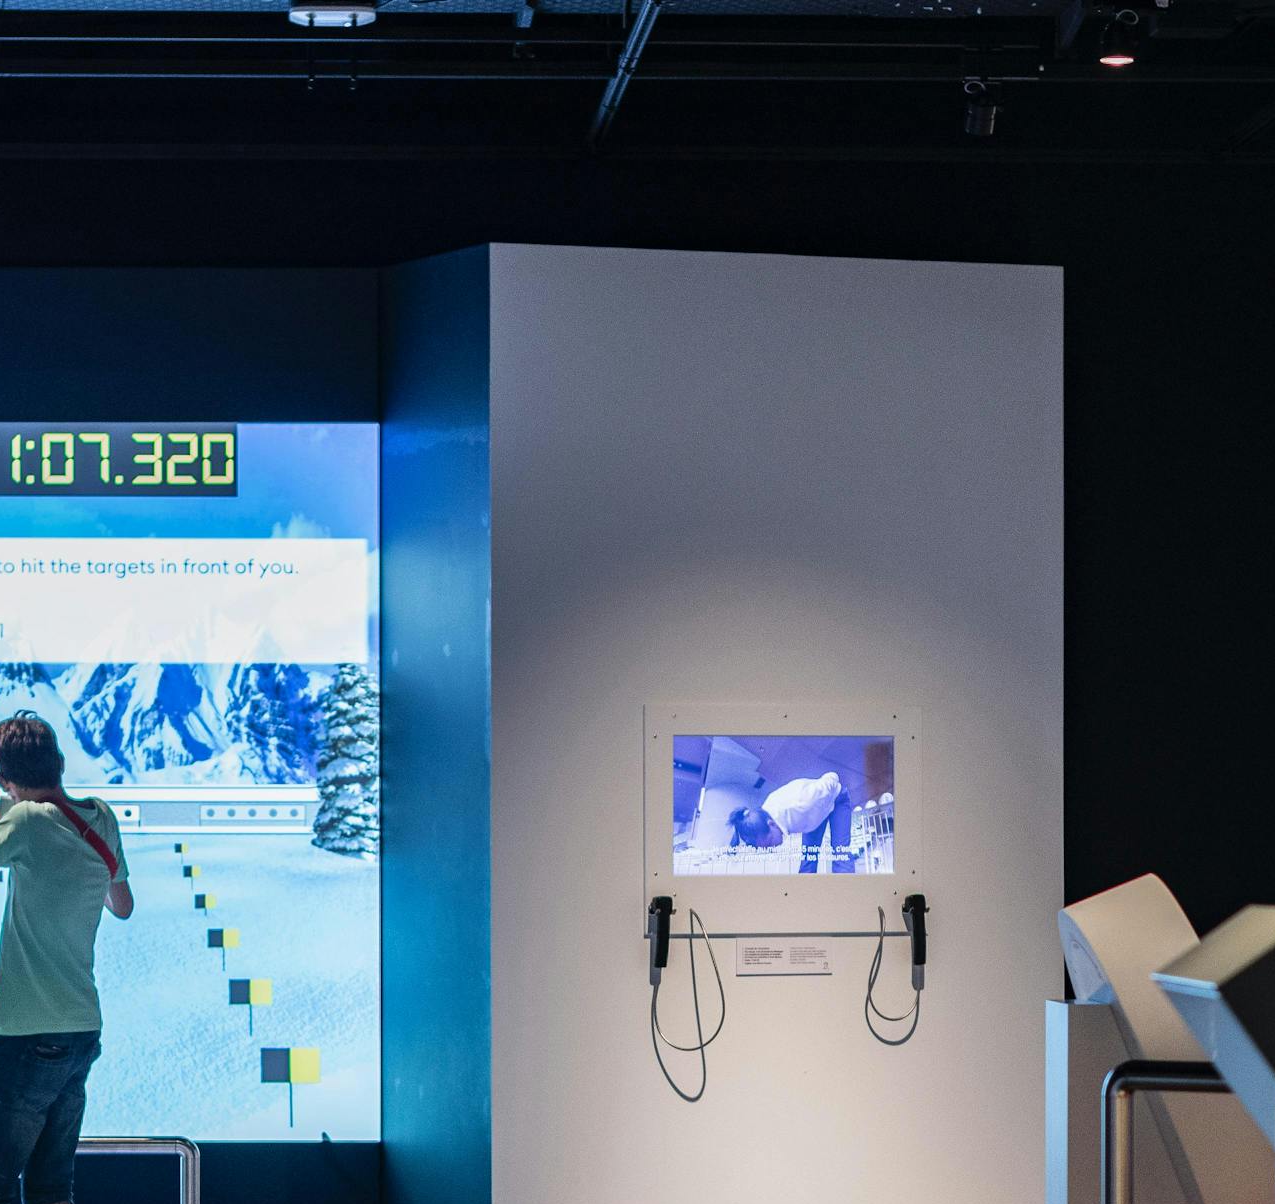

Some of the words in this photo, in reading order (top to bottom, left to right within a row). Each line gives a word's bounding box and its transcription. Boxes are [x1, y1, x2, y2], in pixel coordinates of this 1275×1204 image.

[21, 558, 45, 574] hit
[51, 558, 81, 575] the
[87, 559, 155, 579] targets
[161, 558, 178, 574] in
[183, 557, 230, 575] front
[234, 557, 255, 575] of
[260, 563, 299, 579] you.
[0, 622, 5, 639] 1
